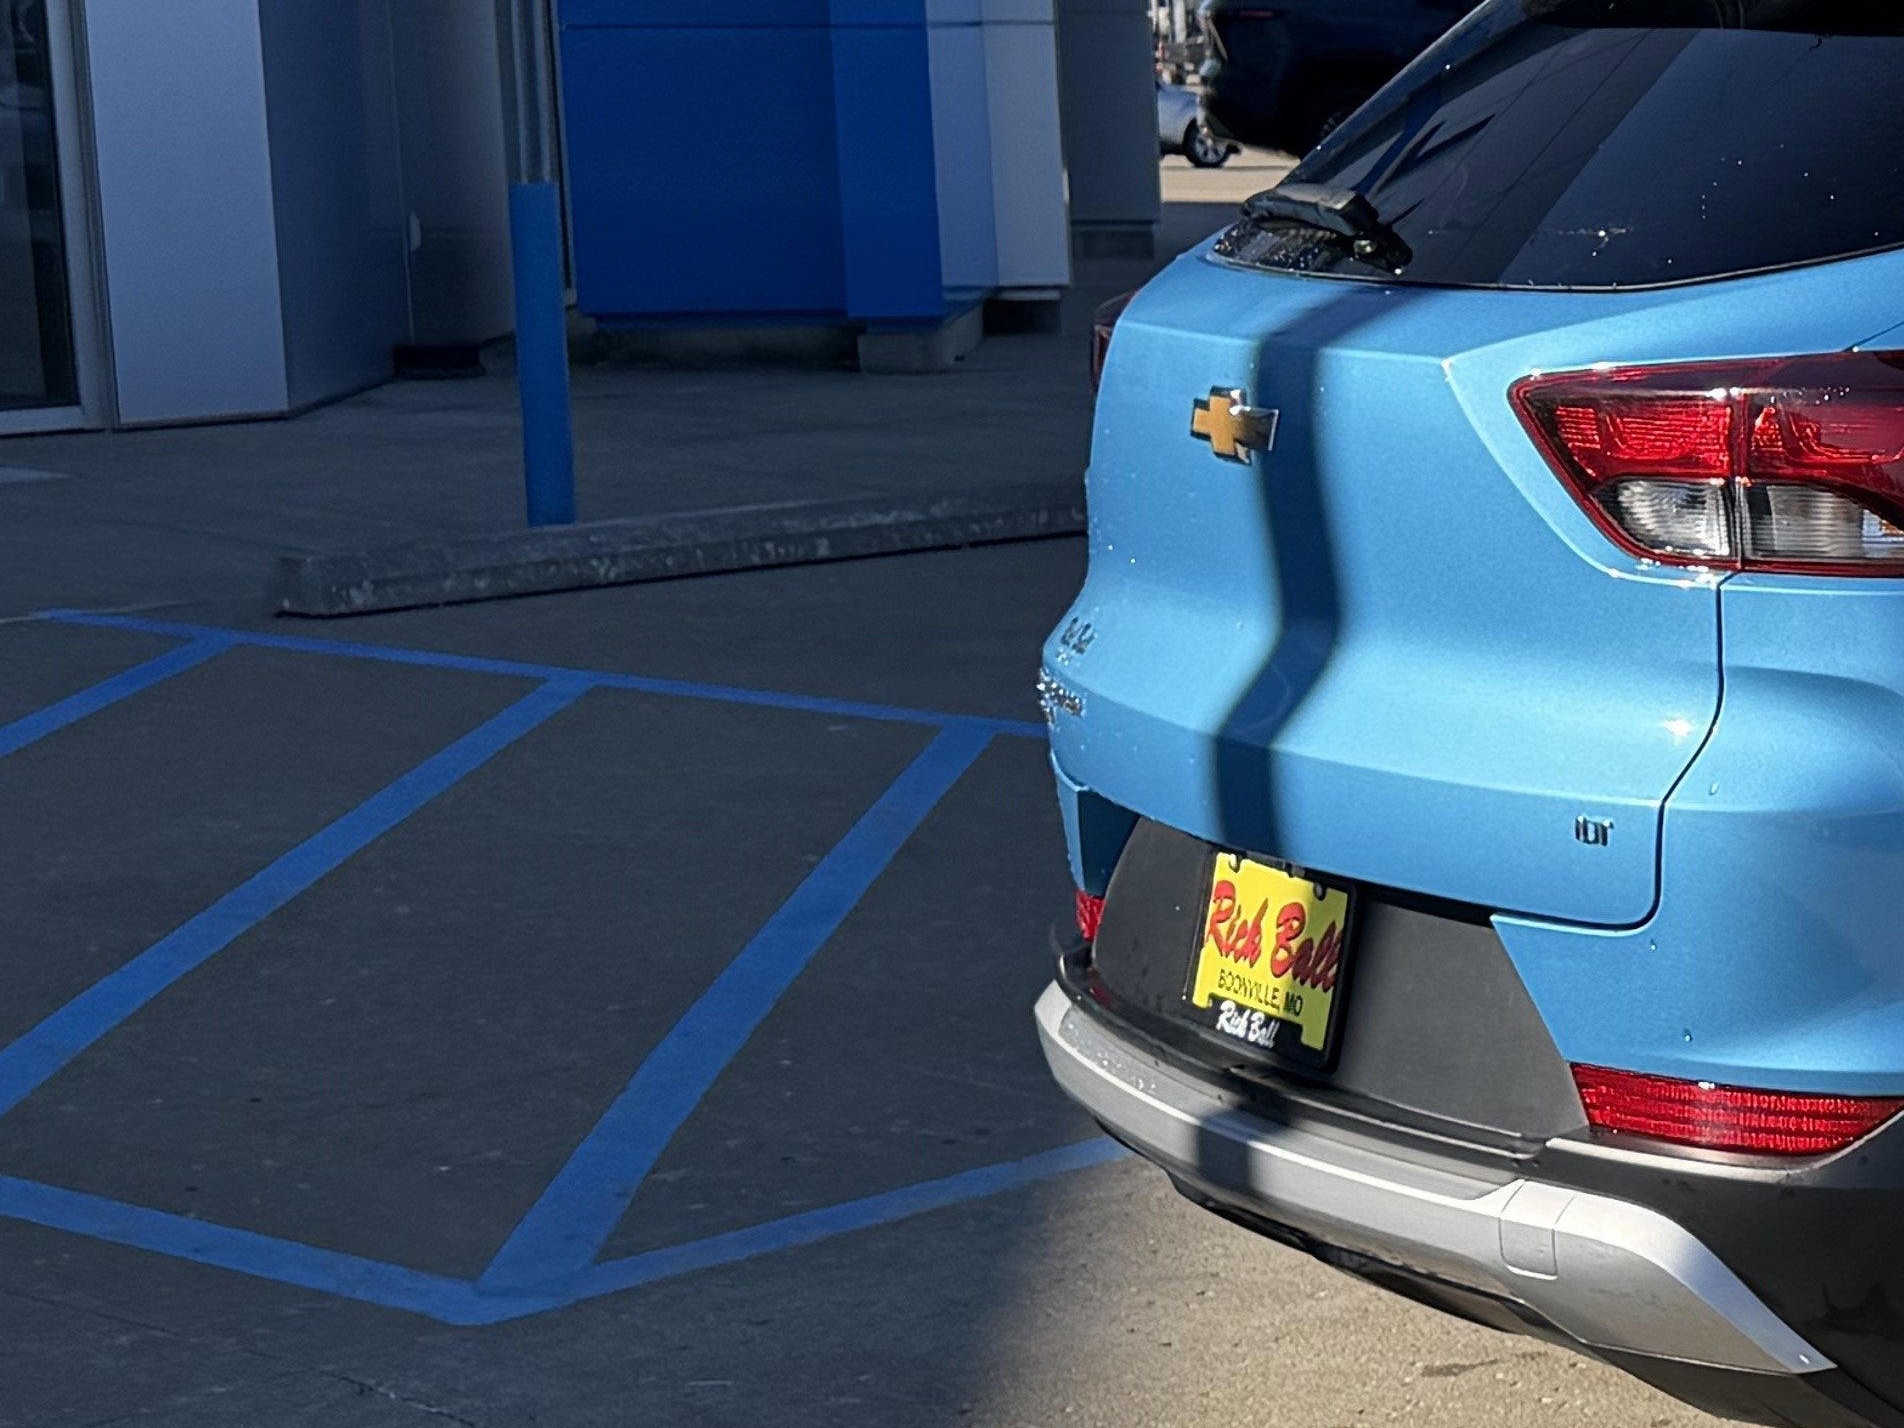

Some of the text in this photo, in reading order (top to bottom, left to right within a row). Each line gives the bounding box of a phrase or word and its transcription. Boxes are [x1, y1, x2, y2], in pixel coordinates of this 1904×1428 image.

[1207, 879, 1344, 993] Rick Ball
[1216, 1000, 1280, 1048] Rick Ball
[1283, 991, 1303, 1016] MO
